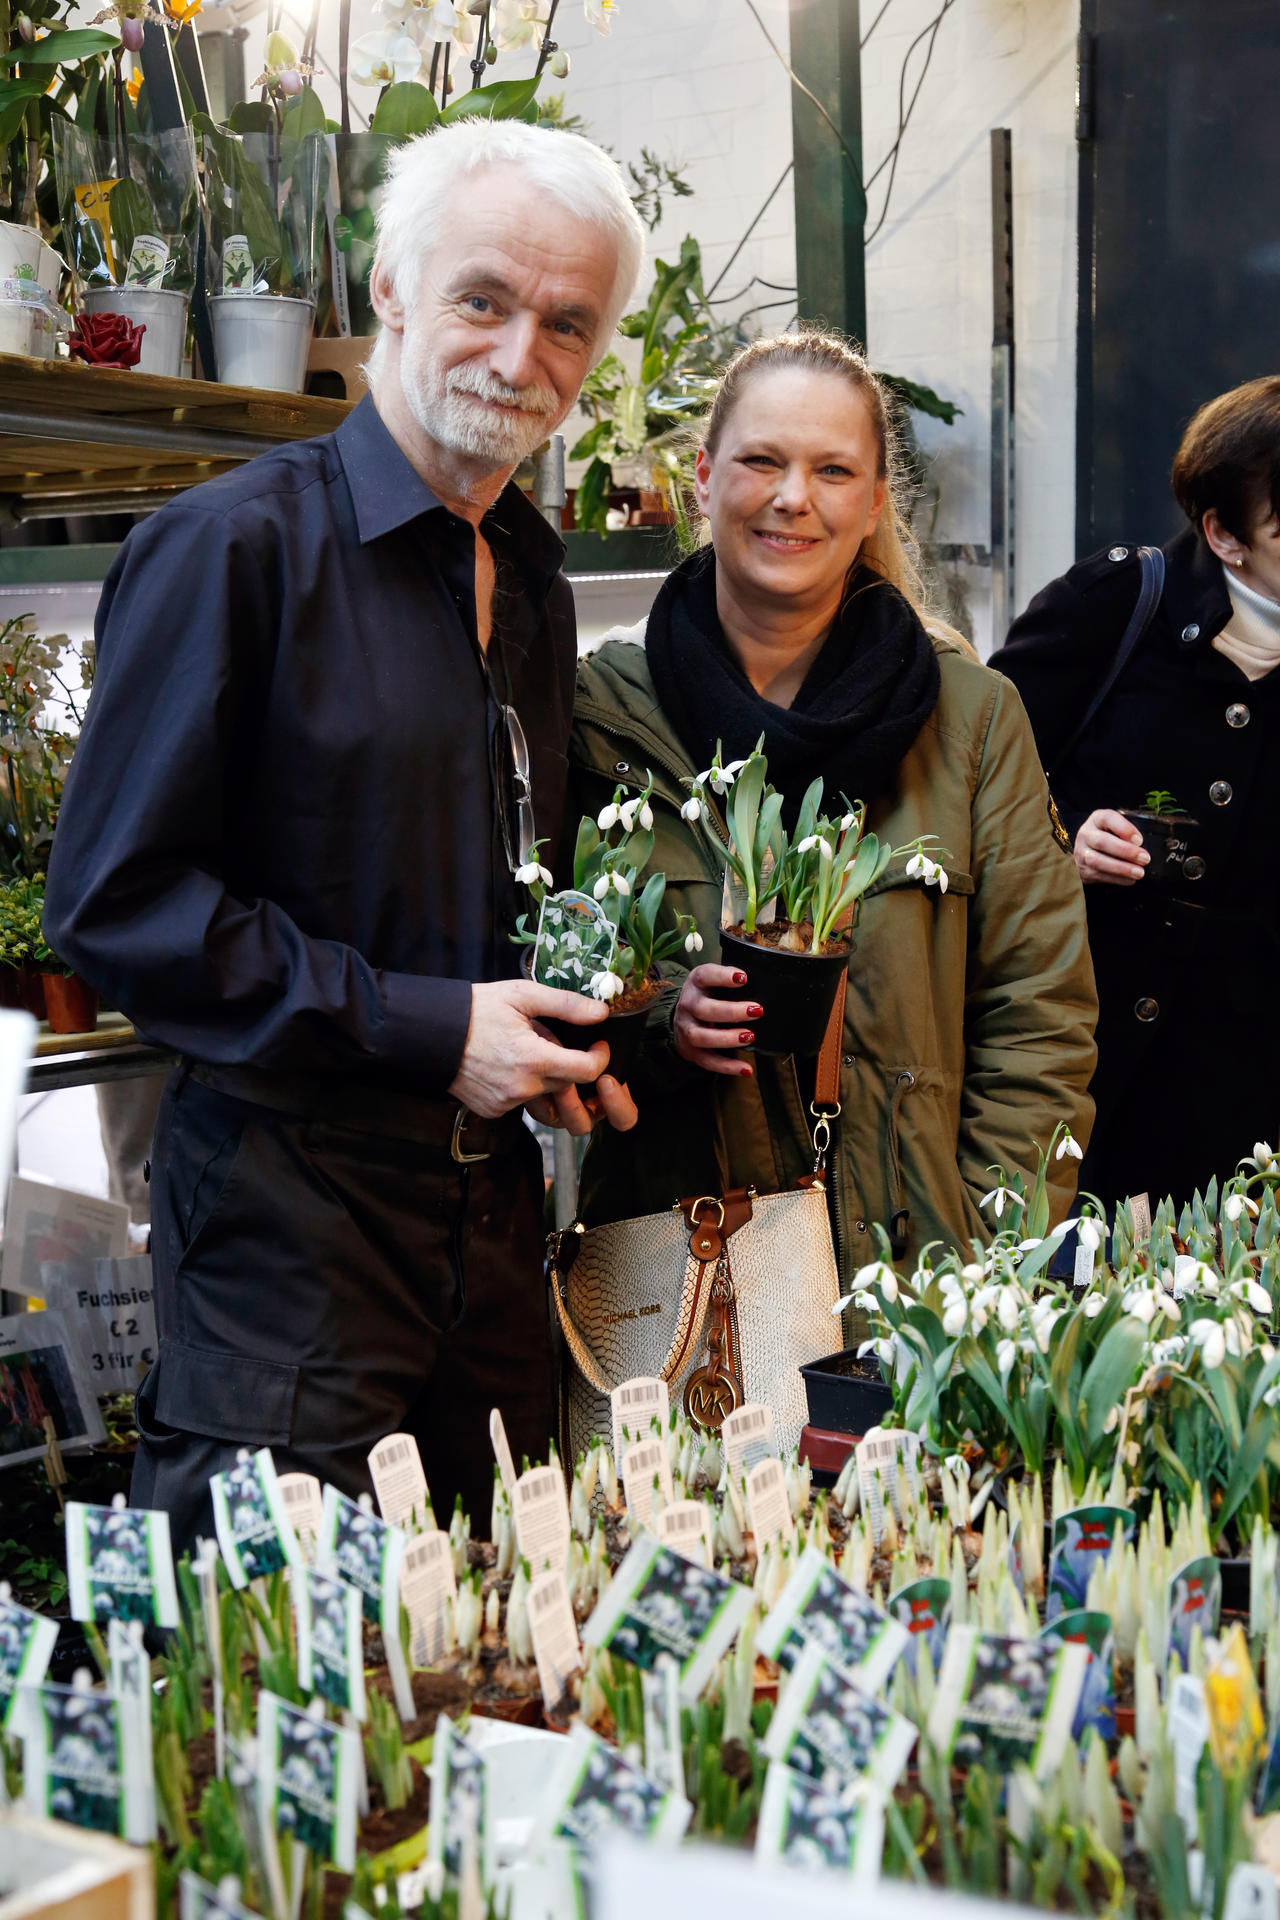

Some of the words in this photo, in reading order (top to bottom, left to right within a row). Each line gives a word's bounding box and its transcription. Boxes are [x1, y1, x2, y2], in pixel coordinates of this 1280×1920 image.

[79, 191, 97, 209] €
[77, 1287, 155, 1308] Fuchsie
[602, 1309, 638, 1325] MICHAEL
[639, 1303, 663, 1317] KORS
[110, 1320, 121, 1338] €
[125, 1318, 139, 1336] 2
[92, 1353, 104, 1371] 3
[141, 1347, 154, 1365] €
[692, 1386, 733, 1419] MK
